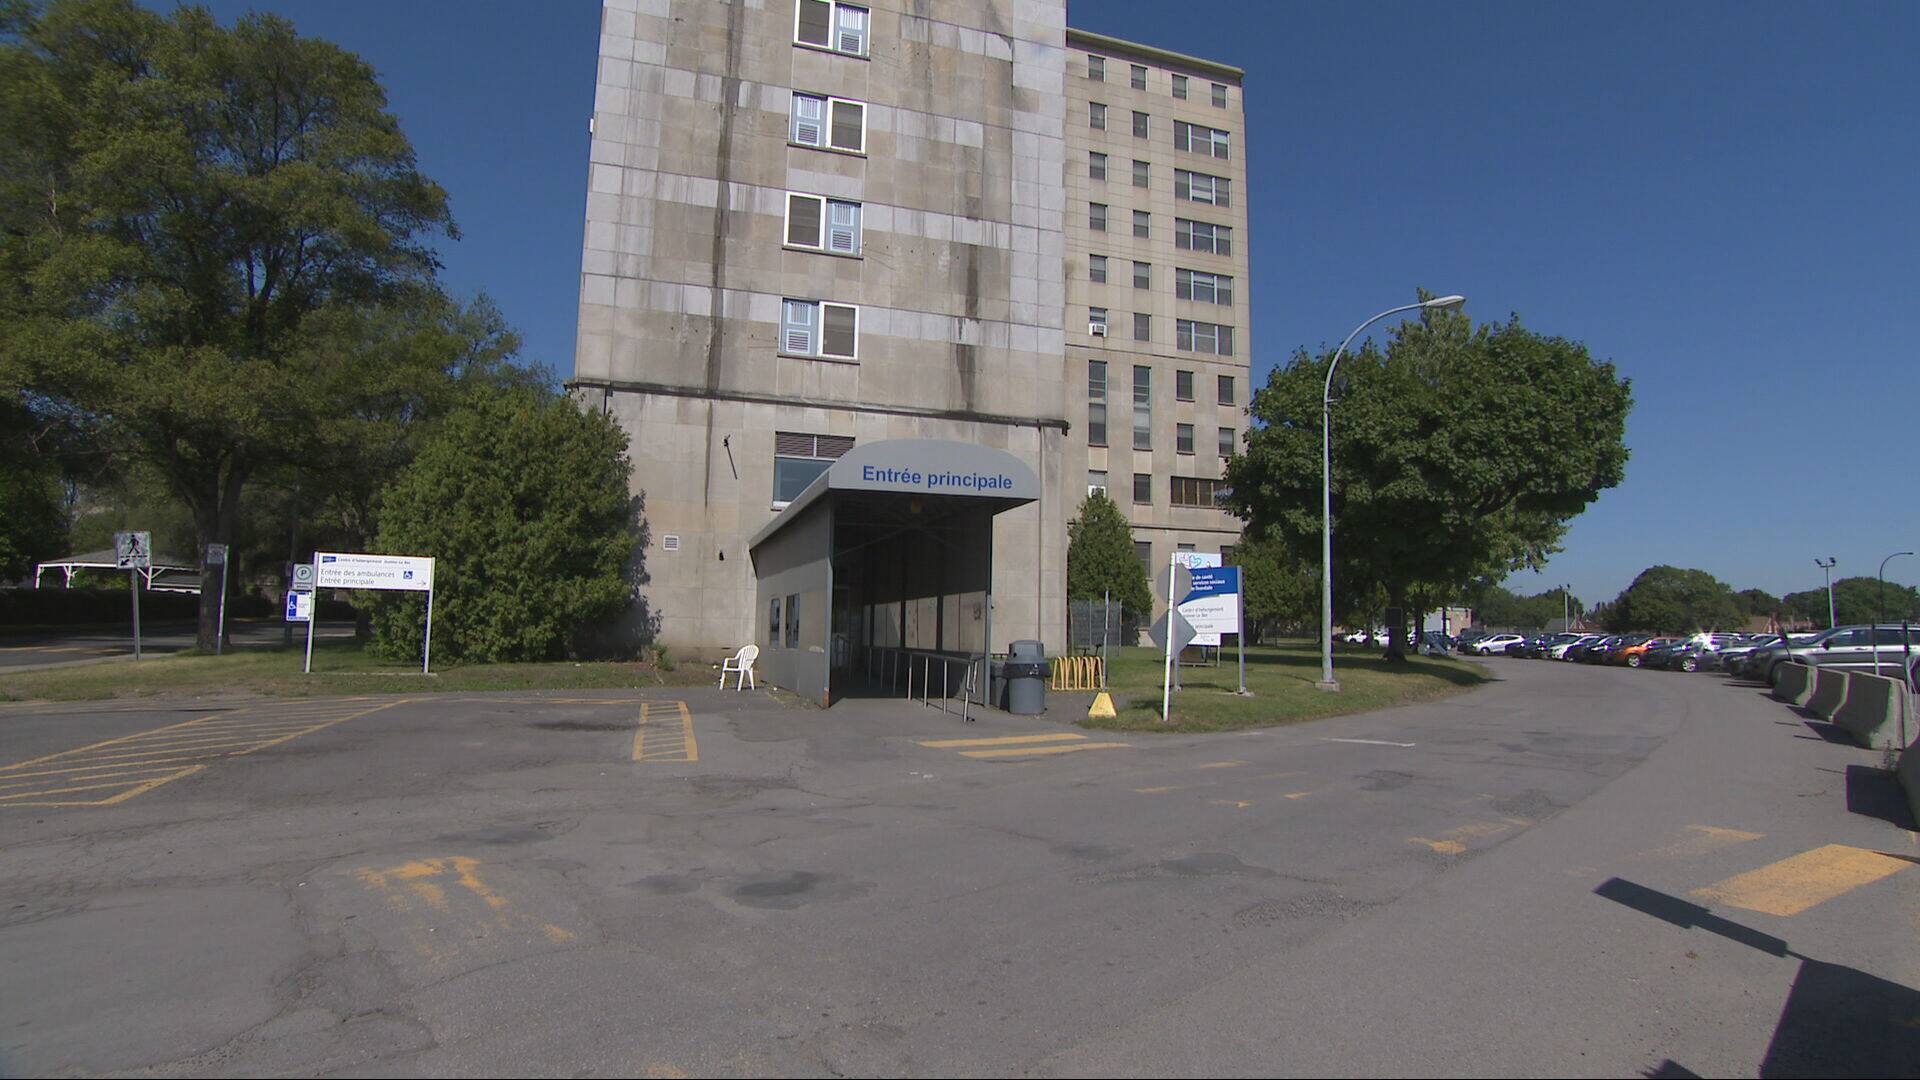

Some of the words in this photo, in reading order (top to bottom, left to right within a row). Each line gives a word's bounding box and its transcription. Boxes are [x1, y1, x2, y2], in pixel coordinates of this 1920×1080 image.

[863, 465, 922, 484] Entrée
[928, 471, 1013, 491] principale
[320, 568, 342, 576] Entrée
[343, 569, 356, 577] des
[356, 570, 395, 578] ambulances
[343, 578, 375, 586] principale
